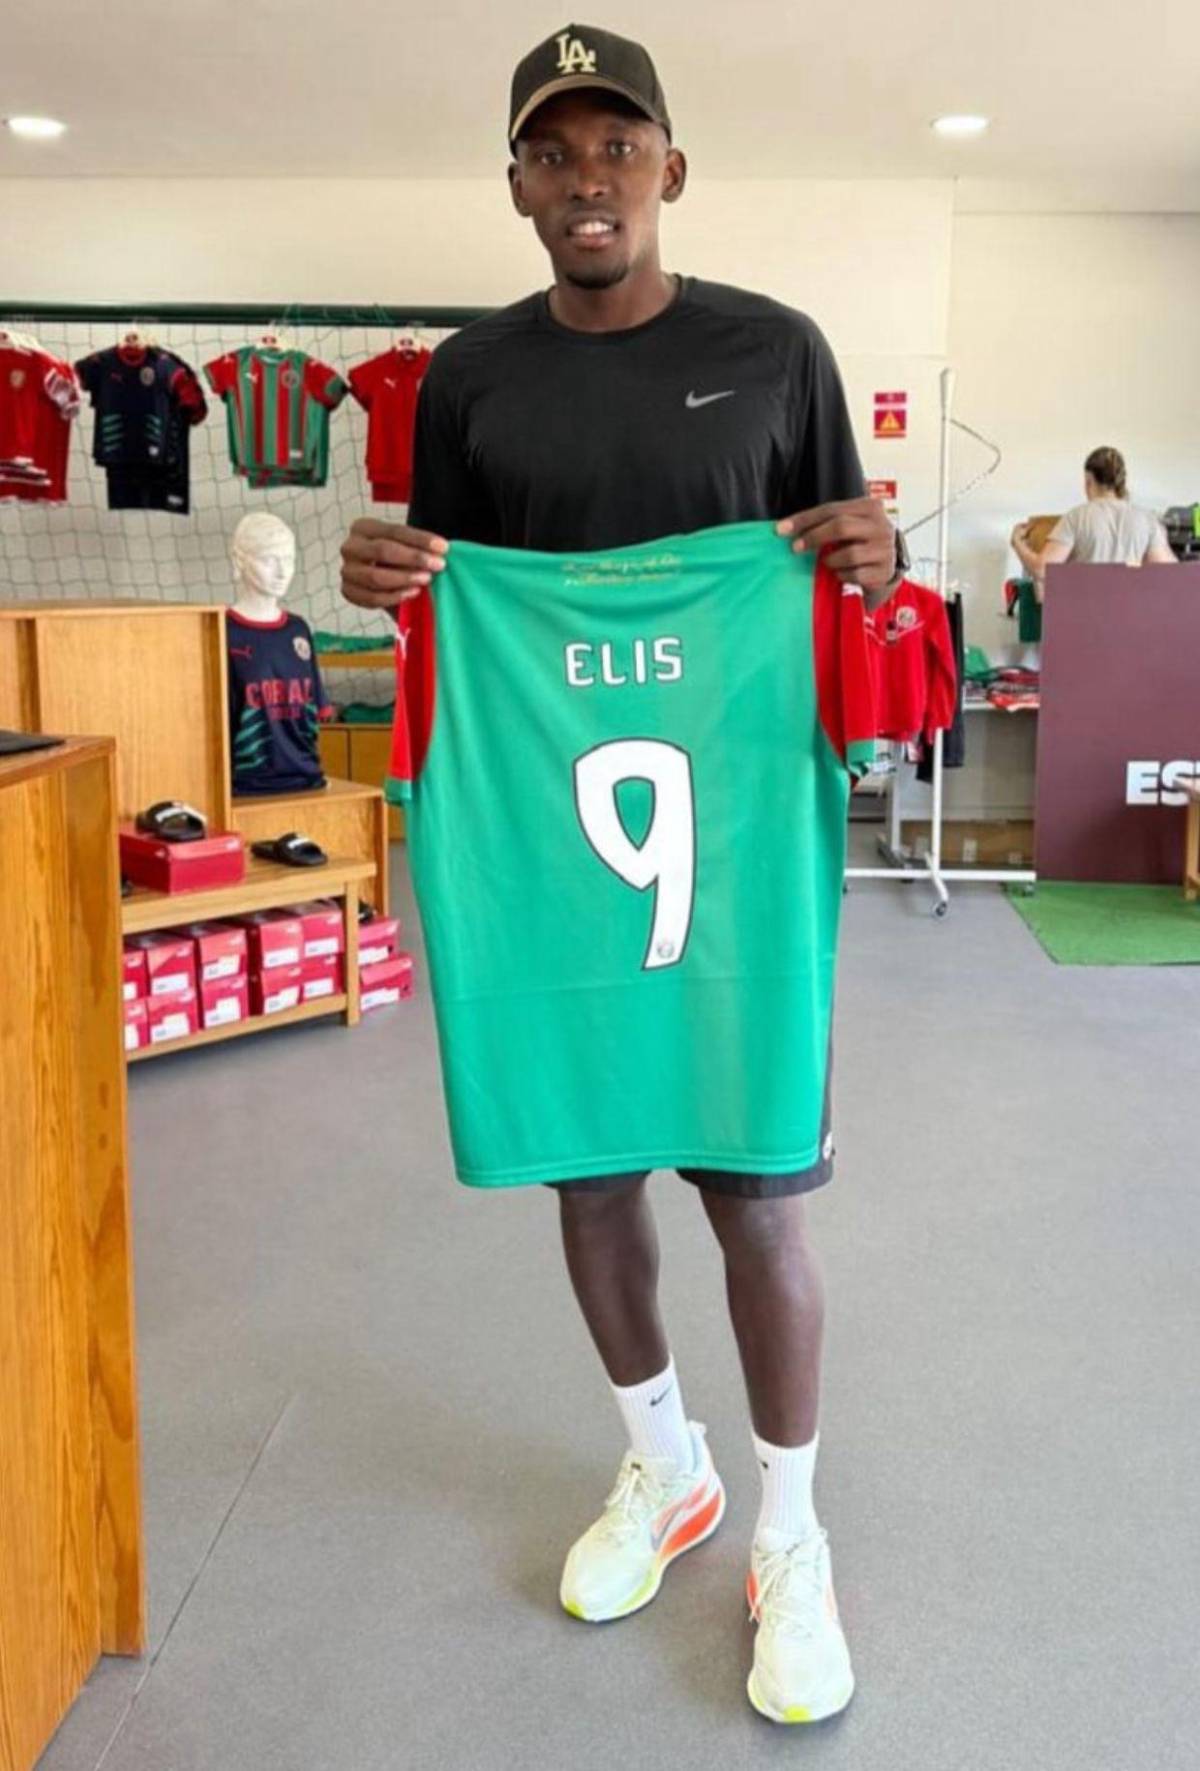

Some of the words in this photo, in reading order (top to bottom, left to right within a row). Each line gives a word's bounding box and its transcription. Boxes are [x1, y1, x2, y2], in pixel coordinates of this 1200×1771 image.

[556, 33, 596, 74] LA
[564, 635, 684, 688] ELIS
[1126, 760, 1200, 806] ES
[572, 736, 697, 972] 9
